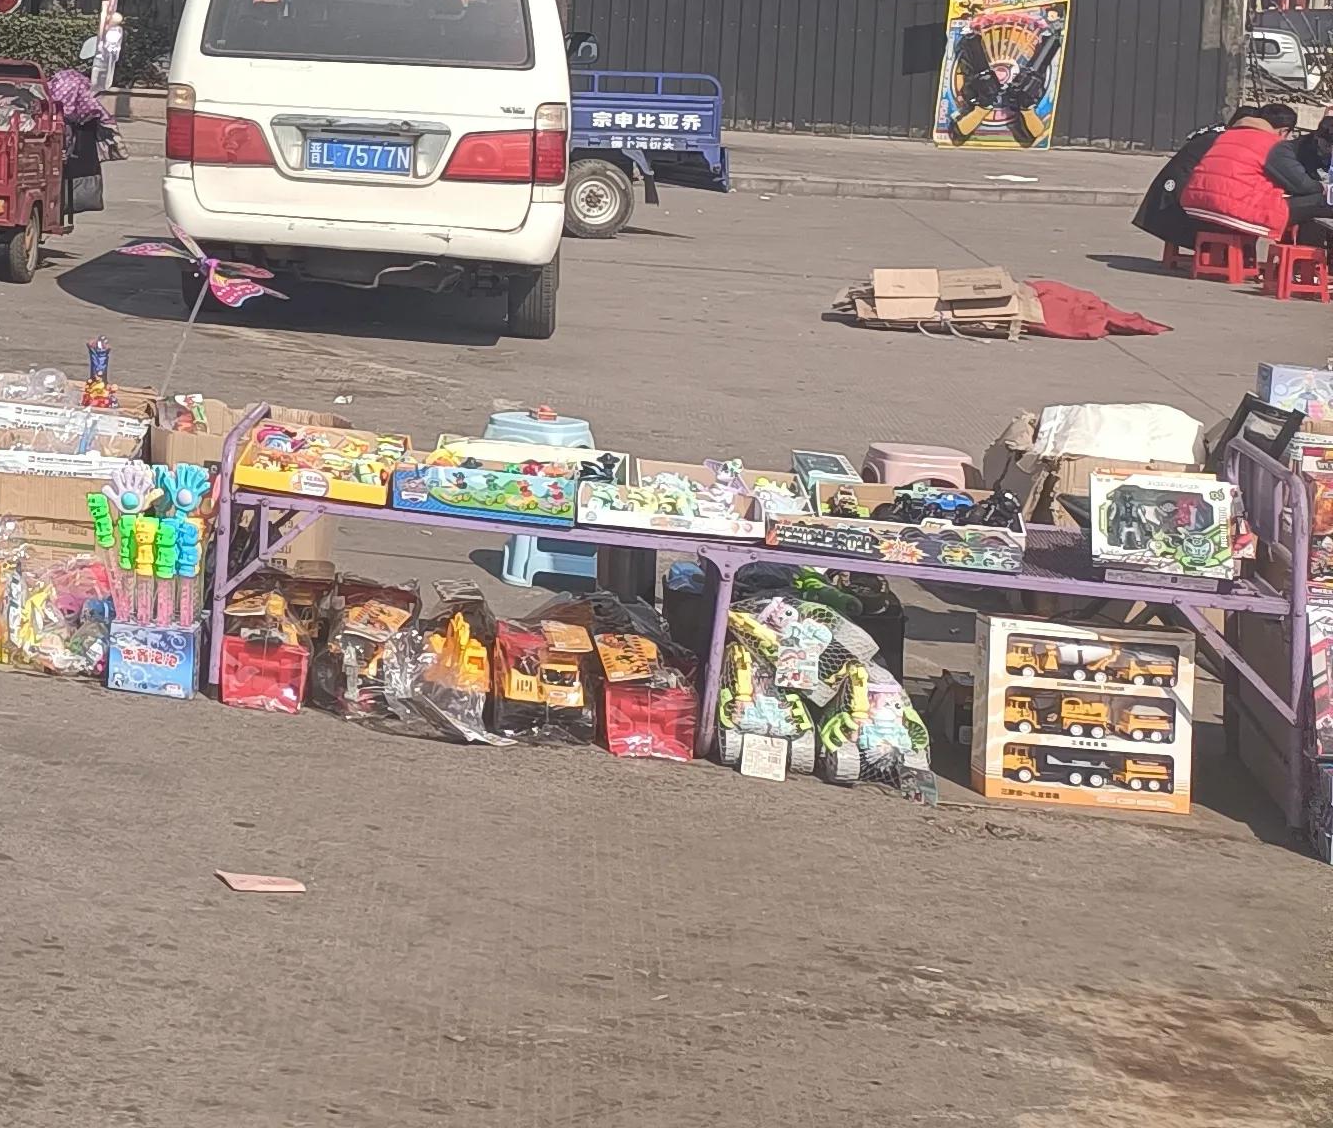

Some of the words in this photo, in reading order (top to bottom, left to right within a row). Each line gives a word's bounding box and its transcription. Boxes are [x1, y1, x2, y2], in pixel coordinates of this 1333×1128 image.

[592, 112, 701, 131] 宗申比亚乔
